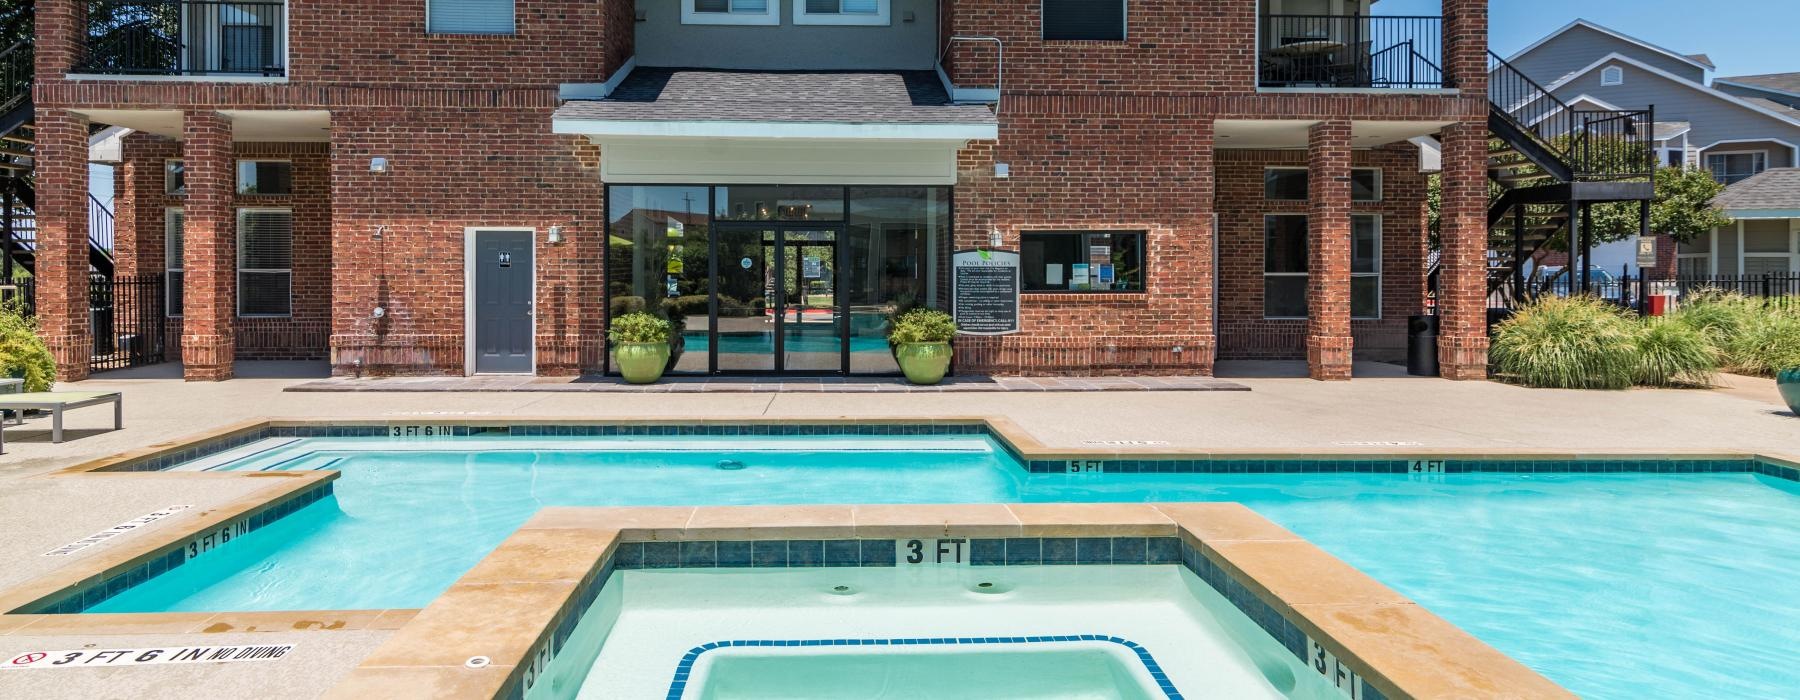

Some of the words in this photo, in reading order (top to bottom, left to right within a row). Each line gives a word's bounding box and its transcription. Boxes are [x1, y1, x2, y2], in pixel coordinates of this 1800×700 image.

[393, 426, 401, 436] 3
[406, 426, 420, 436] FT
[425, 426, 433, 436] 6
[439, 426, 451, 436] IN
[1071, 460, 1080, 473] 5
[1086, 460, 1102, 473] FT
[1413, 460, 1422, 473] 4
[1428, 460, 1443, 473] FT
[189, 541, 198, 559] 3
[203, 531, 218, 552] FT
[222, 526, 230, 544] 6
[235, 519, 247, 538] IN
[906, 539, 924, 564] 3
[936, 538, 967, 564] FT
[52, 651, 83, 665] 3
[84, 650, 134, 664] FT
[134, 649, 164, 662] 6
[168, 647, 212, 661] IN
[206, 647, 238, 660] NO
[232, 645, 292, 660] DIVING
[1314, 641, 1327, 675] 3
[527, 660, 535, 690] 3
